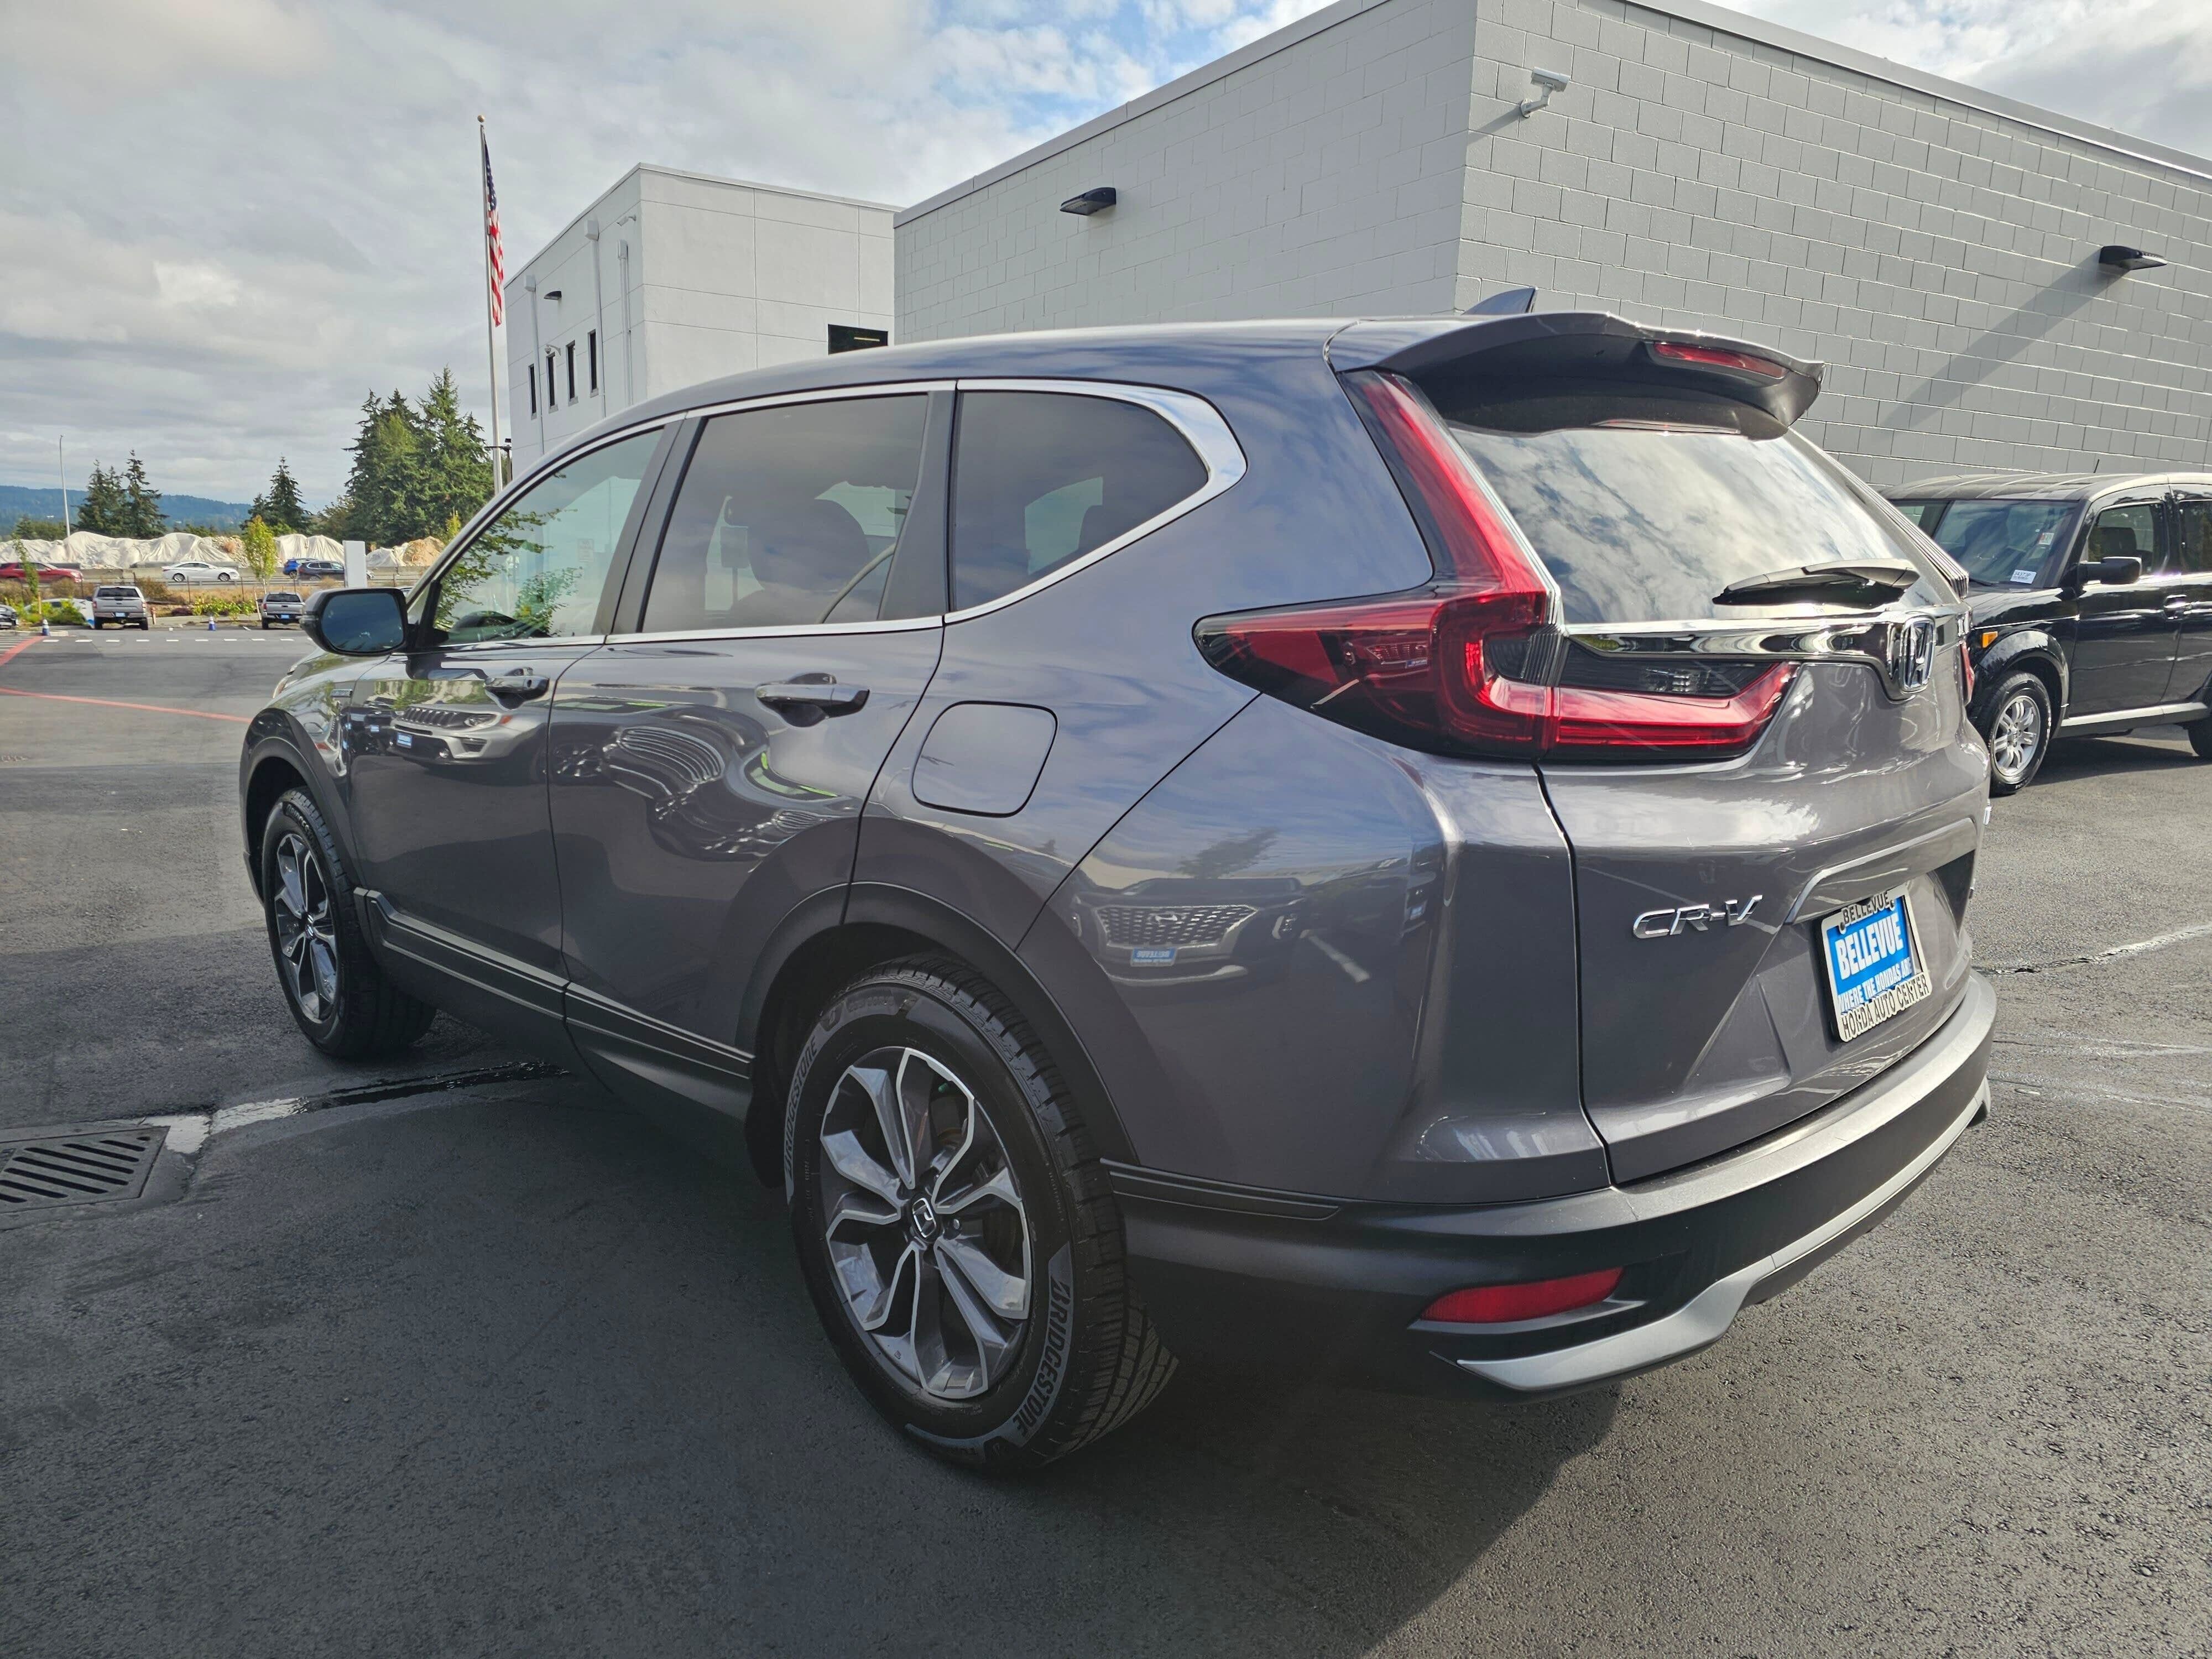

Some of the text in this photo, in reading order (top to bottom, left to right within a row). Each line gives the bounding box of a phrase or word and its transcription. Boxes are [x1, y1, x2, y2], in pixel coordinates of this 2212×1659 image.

[1633, 894, 1763, 939] CR-V
[1842, 892, 1890, 925] BELLEVUE
[1835, 912, 1904, 980] BELLEVUE
[1838, 984, 1864, 1012] WHERE
[1862, 977, 1877, 999] THE
[1875, 964, 1901, 992] HONDAS
[1841, 973, 1930, 1039] HONDA AUTO CENTER
[784, 1035, 817, 1180] BRIDGESTONE
[1012, 1274, 1071, 1437] BRIDGESTONE
